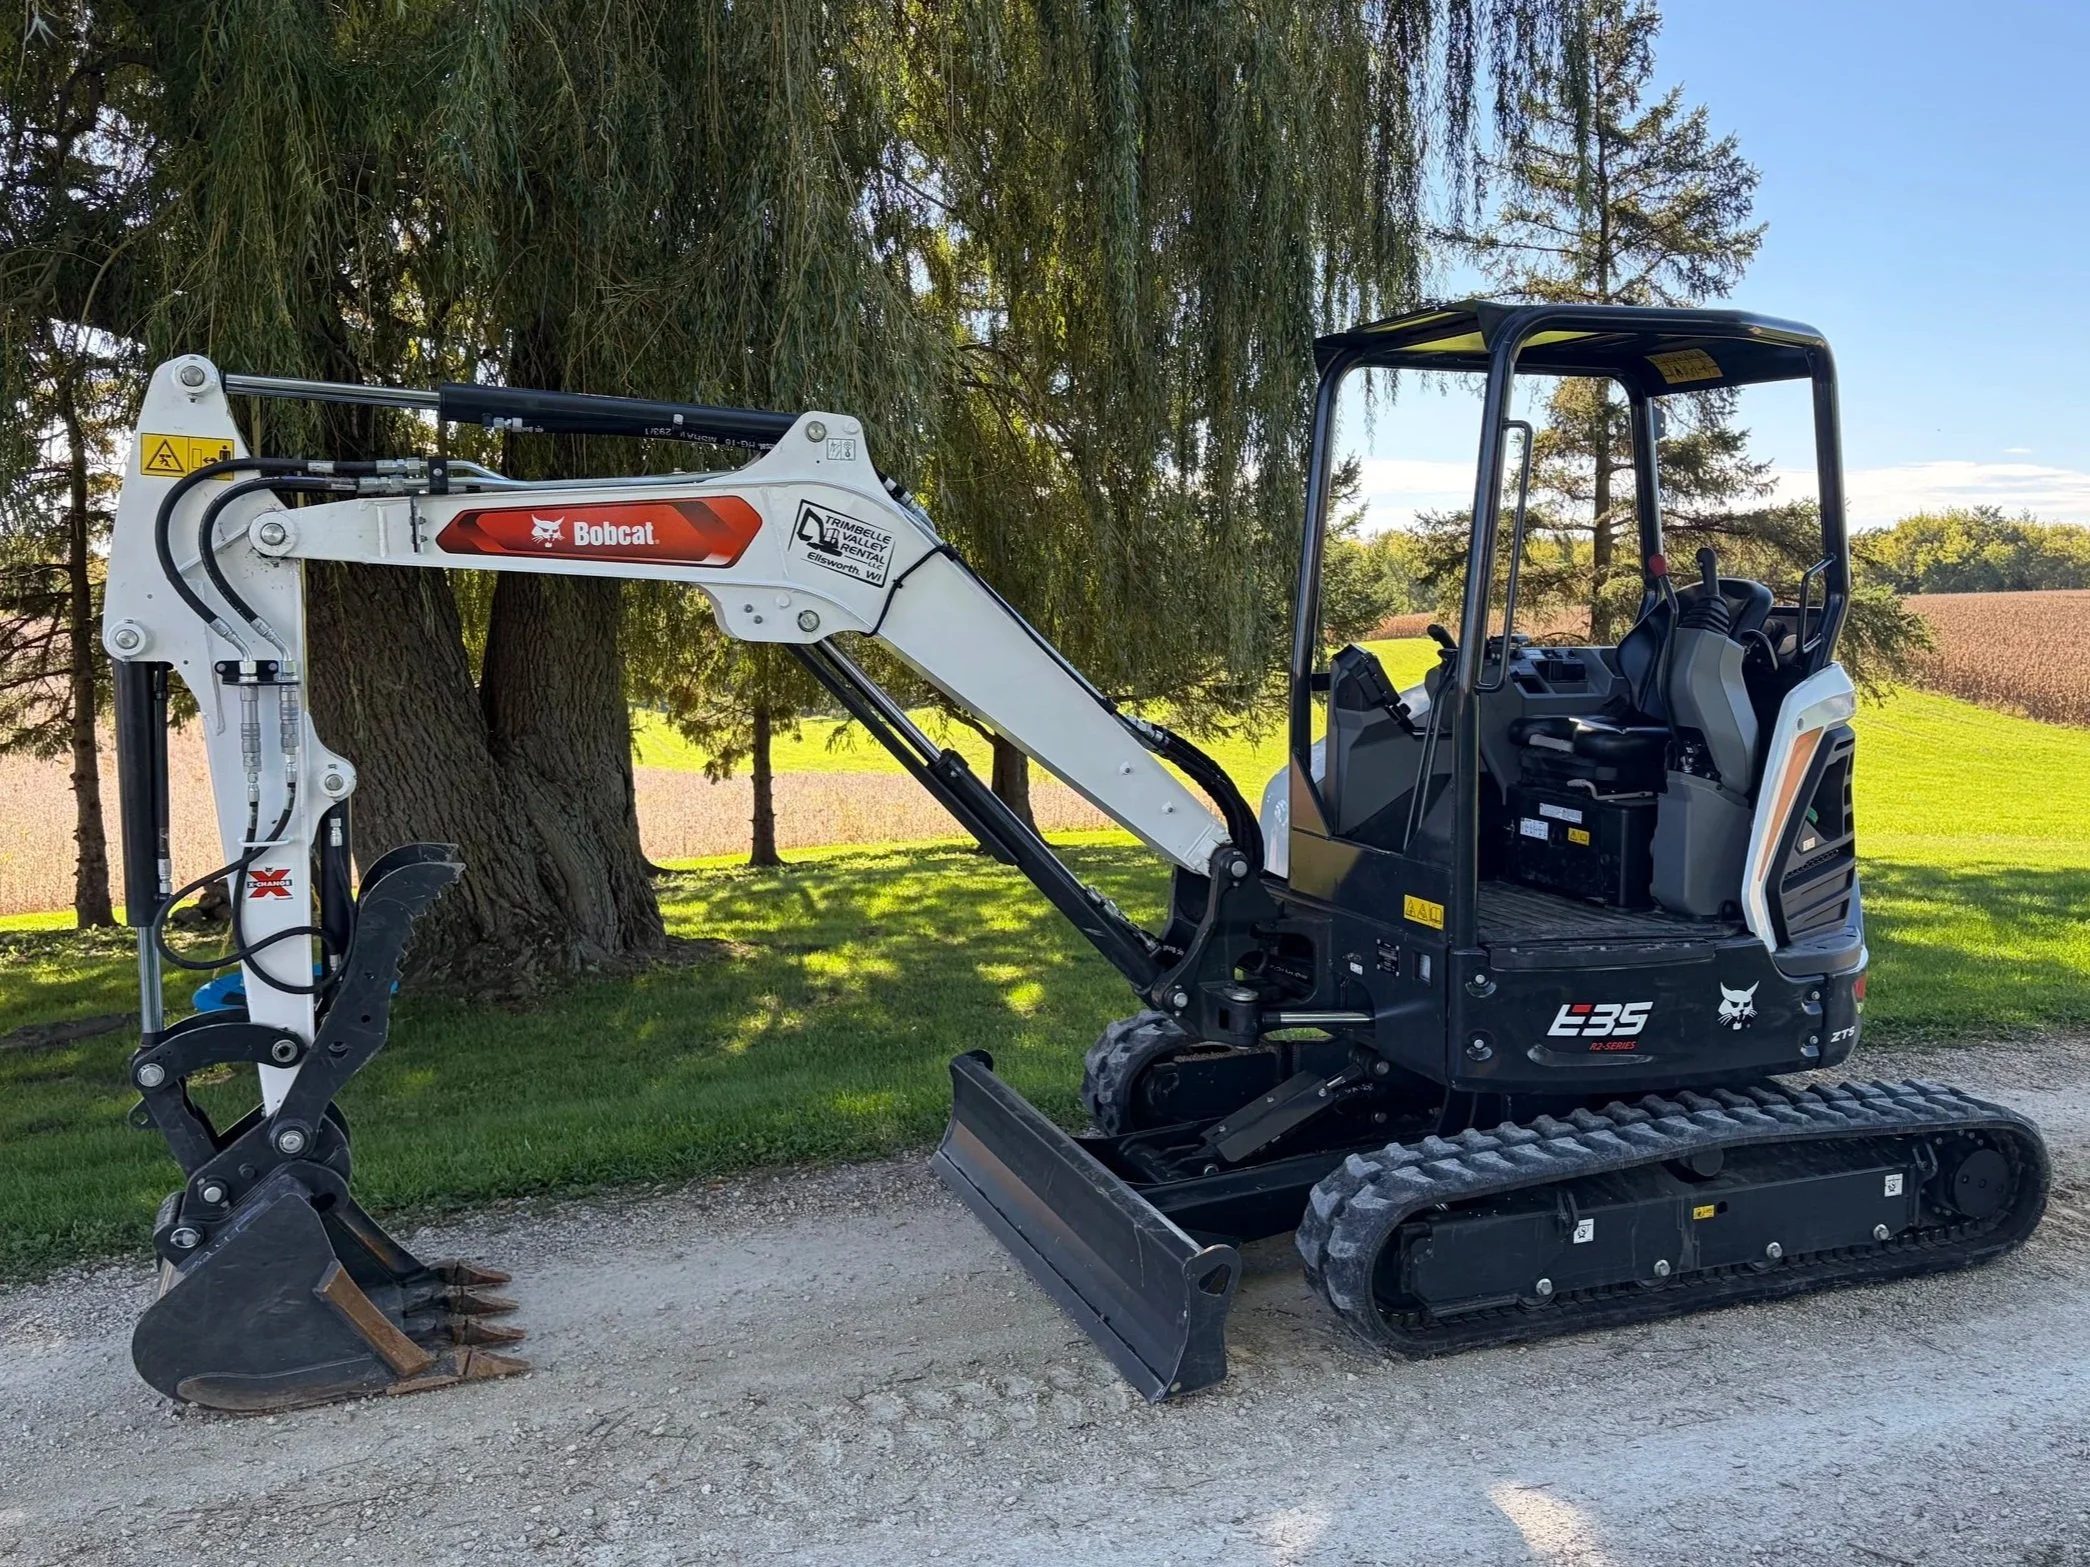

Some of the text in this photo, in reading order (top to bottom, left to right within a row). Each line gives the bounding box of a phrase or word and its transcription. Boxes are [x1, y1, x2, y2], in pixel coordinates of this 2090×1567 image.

[573, 521, 655, 546] Bobcat
[825, 515, 892, 545] TRIMBELLE
[842, 532, 888, 553] VALLEY
[840, 543, 886, 565] RENTAL
[865, 570, 882, 582] WI
[867, 561, 884, 571] LLC
[1546, 1001, 1654, 1037] E35
[1830, 1025, 1856, 1043] ZTS
[1589, 1041, 1638, 1051] R2-SERIES
